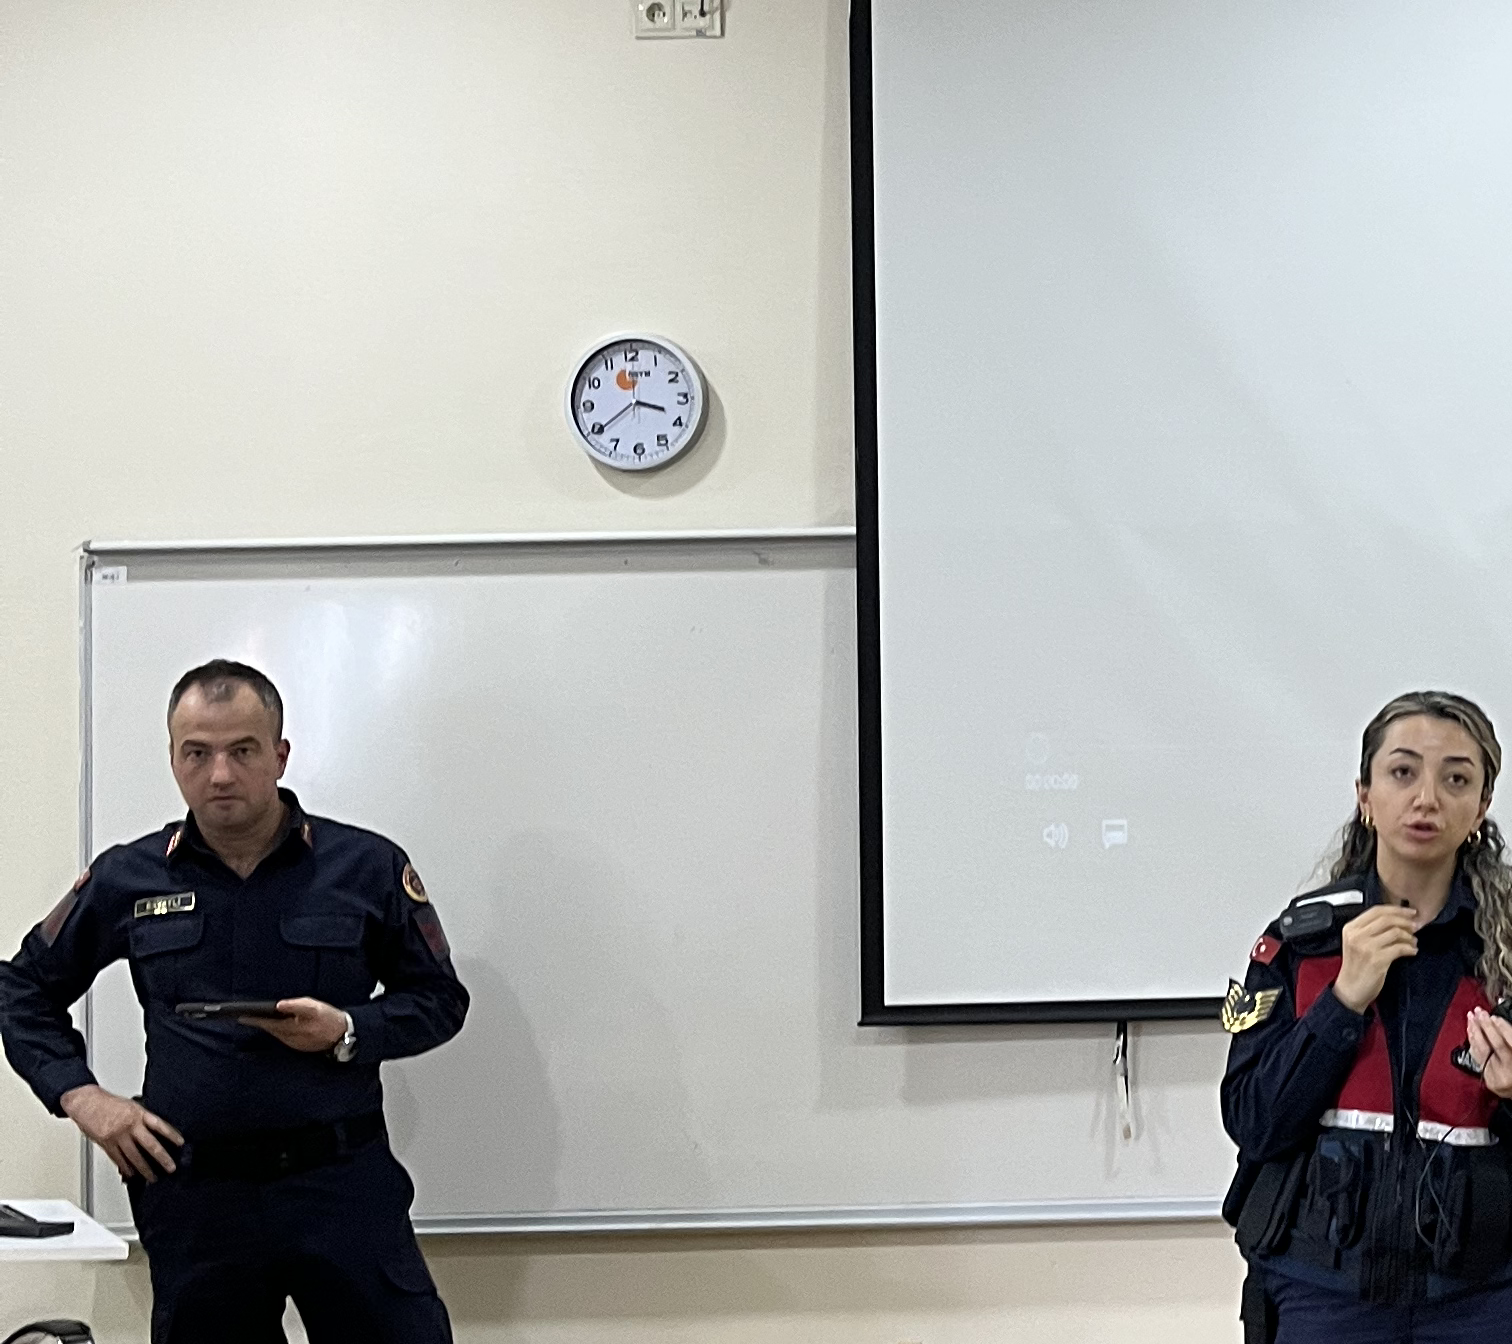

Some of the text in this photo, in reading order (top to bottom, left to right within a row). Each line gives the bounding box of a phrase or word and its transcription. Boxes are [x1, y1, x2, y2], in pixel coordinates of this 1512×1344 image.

[624, 349, 639, 362] 12
[604, 358, 614, 371] 11
[588, 377, 600, 390] 10
[668, 371, 679, 384] 2
[677, 392, 689, 405] 3
[672, 416, 683, 427] 4
[610, 438, 620, 451] 7
[656, 434, 668, 446] 5
[633, 442, 645, 456] 6
